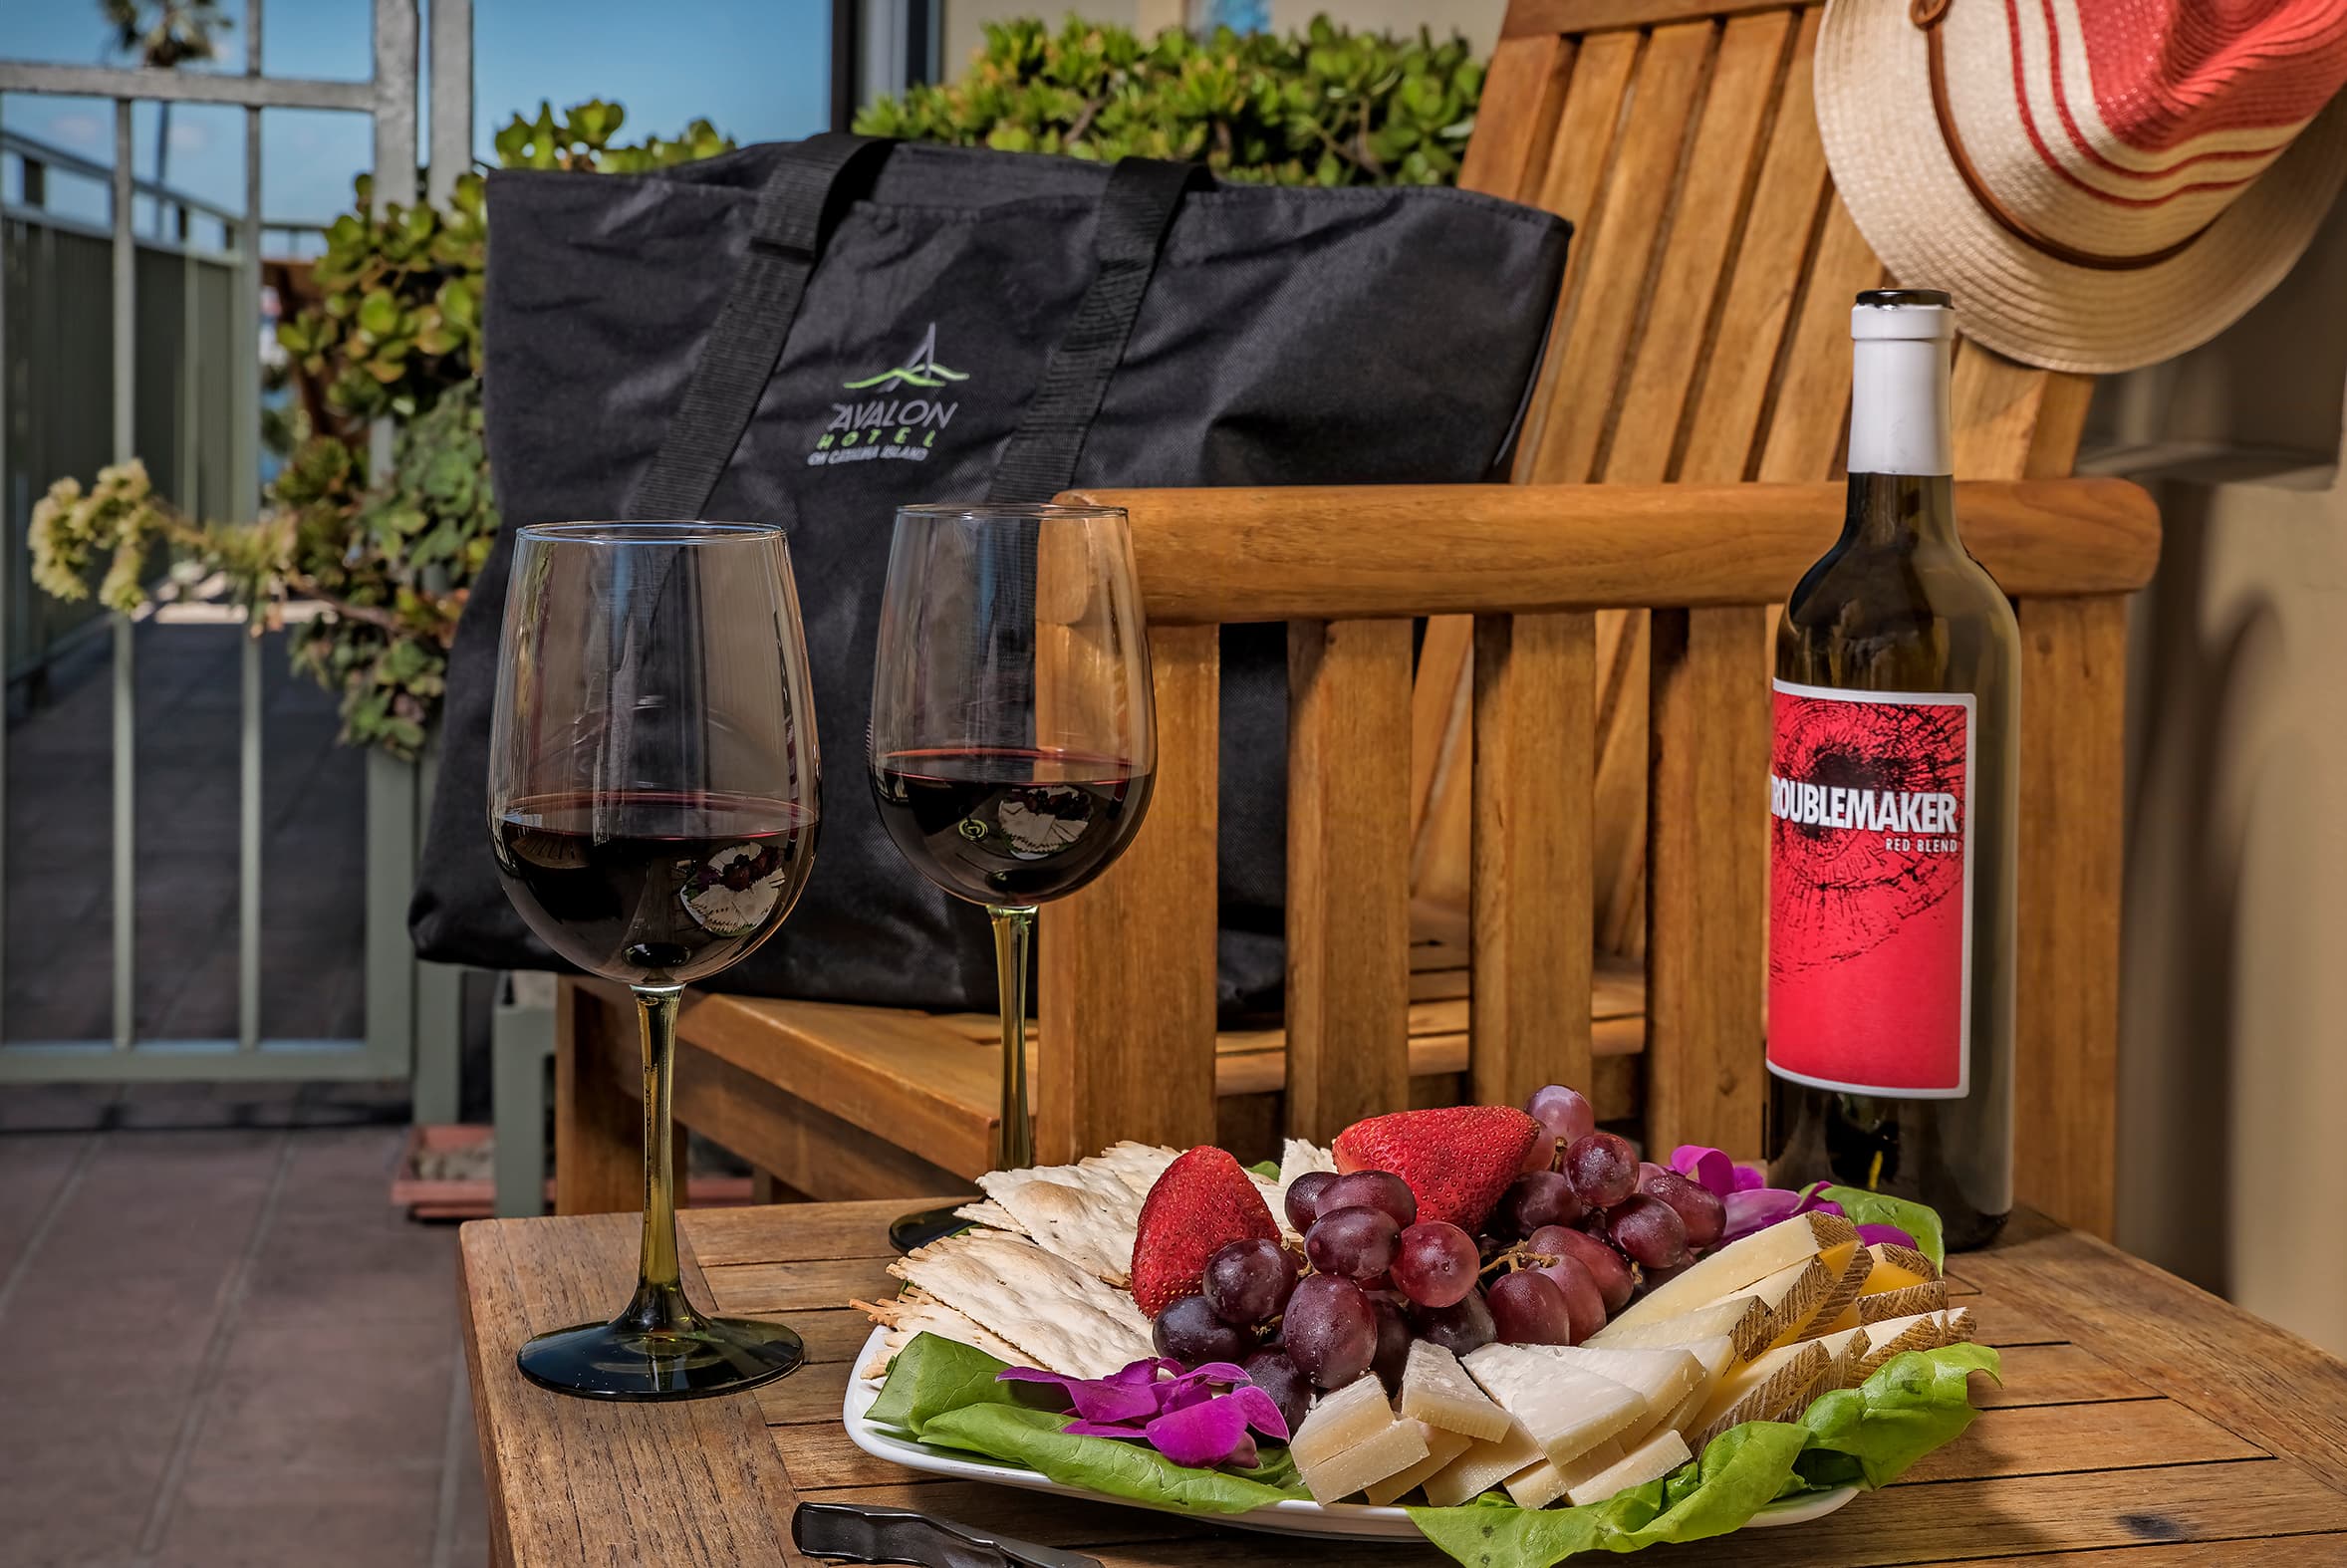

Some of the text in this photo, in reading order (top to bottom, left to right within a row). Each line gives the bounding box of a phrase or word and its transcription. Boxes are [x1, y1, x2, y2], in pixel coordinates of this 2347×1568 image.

[827, 399, 958, 431] AVALON
[816, 426, 936, 449] HOTEL
[1771, 774, 1957, 833] ROUBLEMAKER
[1885, 838, 1957, 853] RED BLEND
